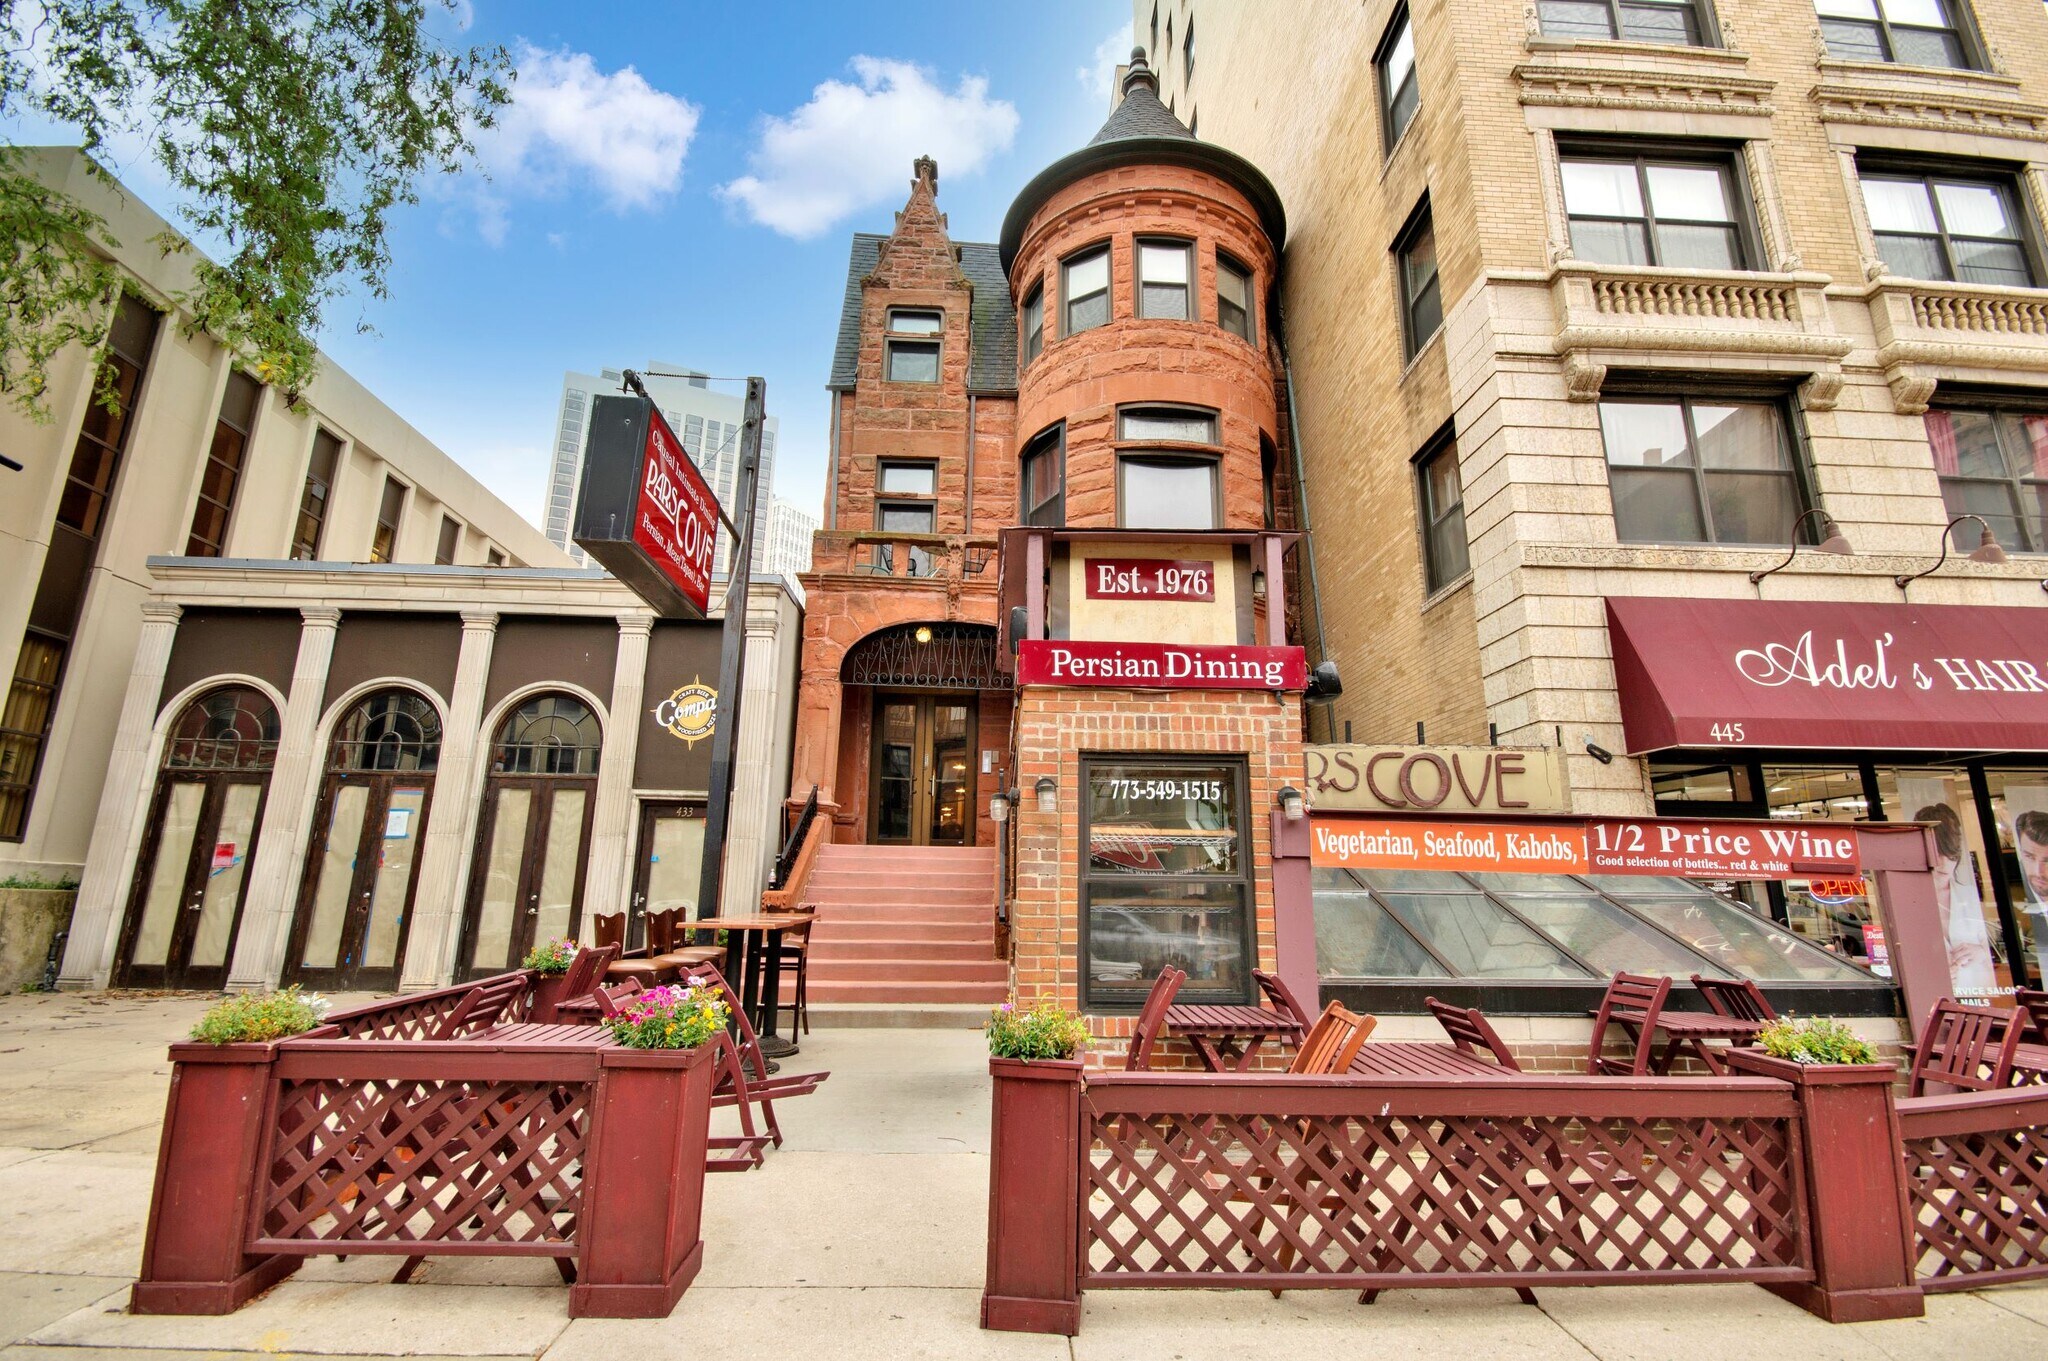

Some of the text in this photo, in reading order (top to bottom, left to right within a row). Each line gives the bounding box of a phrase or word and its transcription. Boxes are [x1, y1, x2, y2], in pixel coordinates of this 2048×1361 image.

[676, 461, 700, 504] Intimate
[645, 458, 714, 580] PARS COVE
[1097, 564, 1208, 595] Est. 1976
[1051, 649, 1284, 686] Persian Dining
[1934, 658, 2048, 692] HAIR
[1710, 722, 1745, 742] 445
[1110, 779, 1220, 801] 773-549-1515
[1366, 752, 1529, 808] COVE
[675, 806, 694, 818] 433
[1316, 827, 1418, 860] Vegetarian,
[1423, 830, 1500, 862] Seafood,
[1505, 833, 1578, 864] Kabobs,
[1593, 824, 1645, 852] 1/2
[1657, 825, 1751, 856] Price
[1759, 829, 1853, 859] Wine
[1596, 854, 1624, 866] Good
[1626, 856, 1670, 868] selection
[1672, 857, 1683, 868] of
[1730, 860, 1746, 870] red
[1749, 860, 1759, 871] &
[1762, 861, 1789, 872] white
[1810, 879, 1866, 897] OPEN
[1954, 987, 1985, 996] RVICE
[1960, 998, 1990, 1007] NAILS
